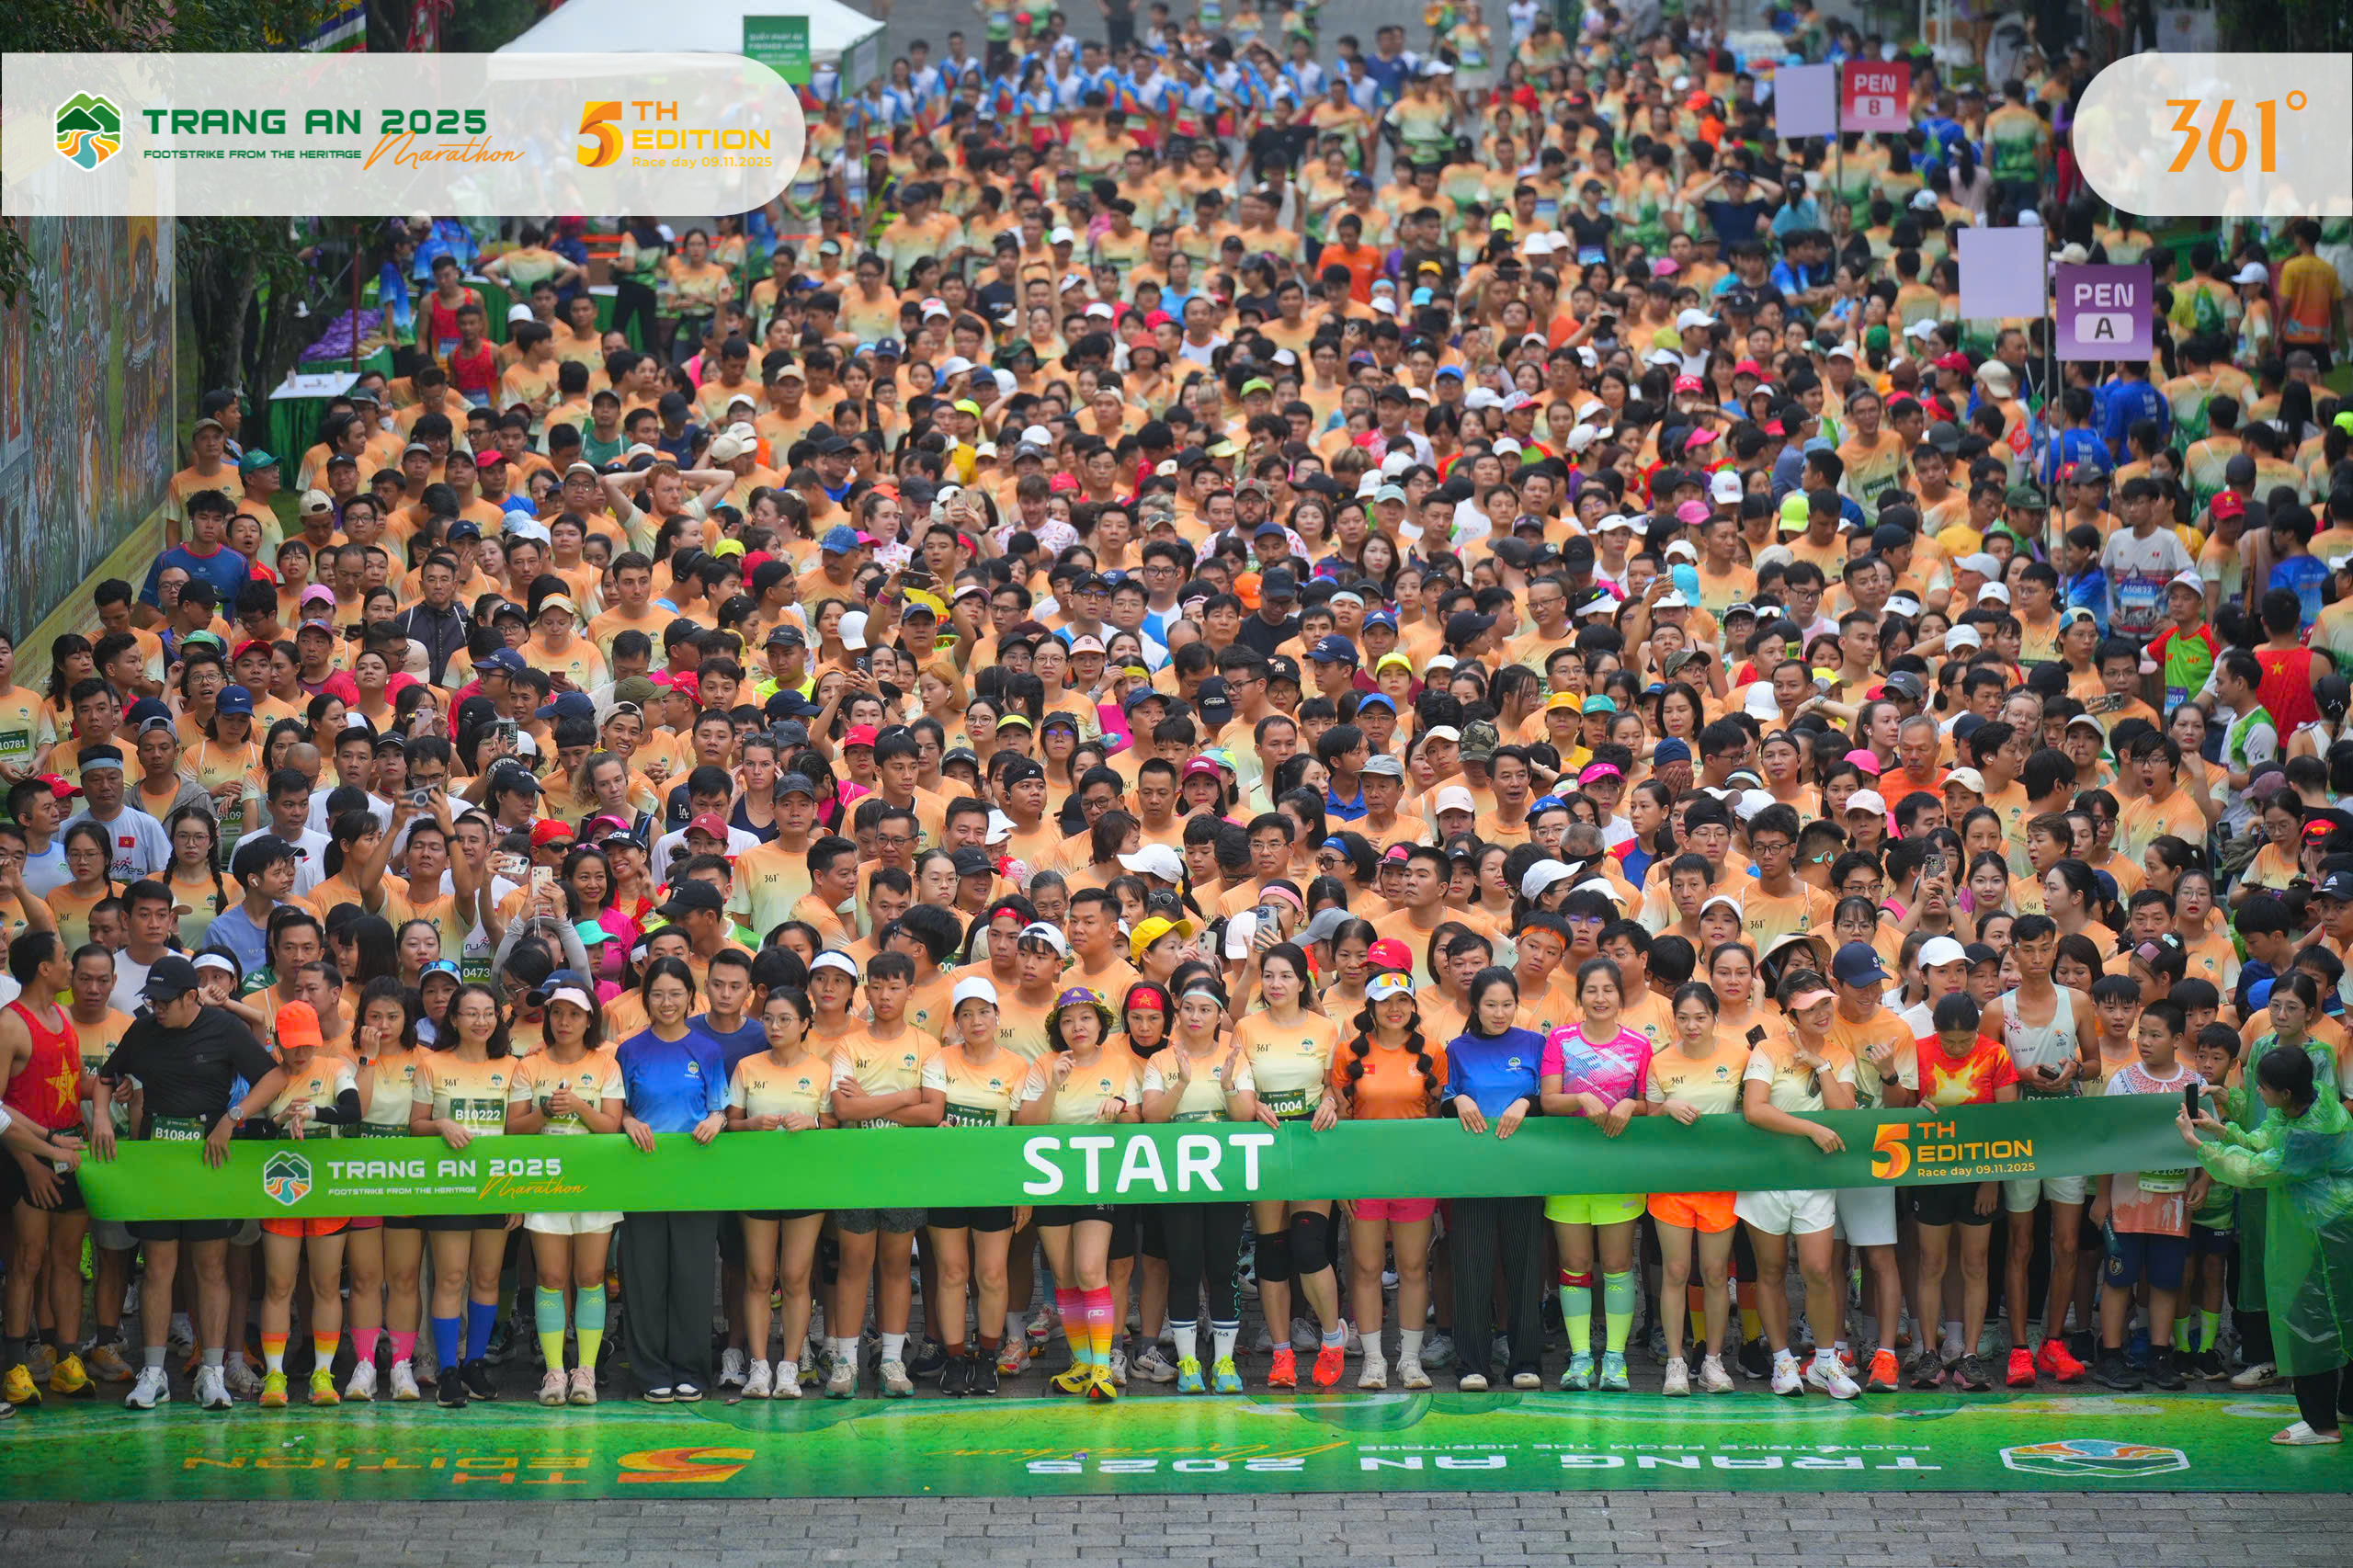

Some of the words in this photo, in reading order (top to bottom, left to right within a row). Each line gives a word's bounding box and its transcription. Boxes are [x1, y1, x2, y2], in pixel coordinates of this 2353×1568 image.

[1854, 74, 1897, 92] PEN
[1869, 98, 1881, 117] B
[2075, 283, 2133, 307] PEN
[2095, 317, 2114, 339] A
[0, 739, 27, 751] 10781
[462, 968, 491, 978] 0473
[455, 1109, 501, 1121] B10222
[1266, 1100, 1302, 1114] 1004
[154, 1127, 200, 1141] B10849
[1916, 1120, 1956, 1140] TH
[1871, 1123, 1911, 1179] 5
[1917, 1139, 2033, 1163] EDITION
[327, 1160, 426, 1179] TRANG
[438, 1159, 476, 1177] AN
[489, 1158, 562, 1176] 2025
[1023, 1133, 1275, 1196] START
[1917, 1167, 1947, 1177] Race
[1950, 1165, 1972, 1176] day
[1976, 1163, 2036, 1175] 09.11.2025
[328, 1187, 384, 1196] FOOTSTRIKE
[386, 1187, 412, 1195] FROM
[415, 1187, 432, 1195] THE
[434, 1186, 476, 1194] HERITAGE
[477, 1172, 588, 1200] Marathon
[179, 1456, 589, 1469] EDITION
[1026, 1458, 1305, 1473] 2025
[1359, 1454, 1506, 1470] AN
[1558, 1453, 1942, 1470] TRANG
[449, 1471, 587, 1483] TH
